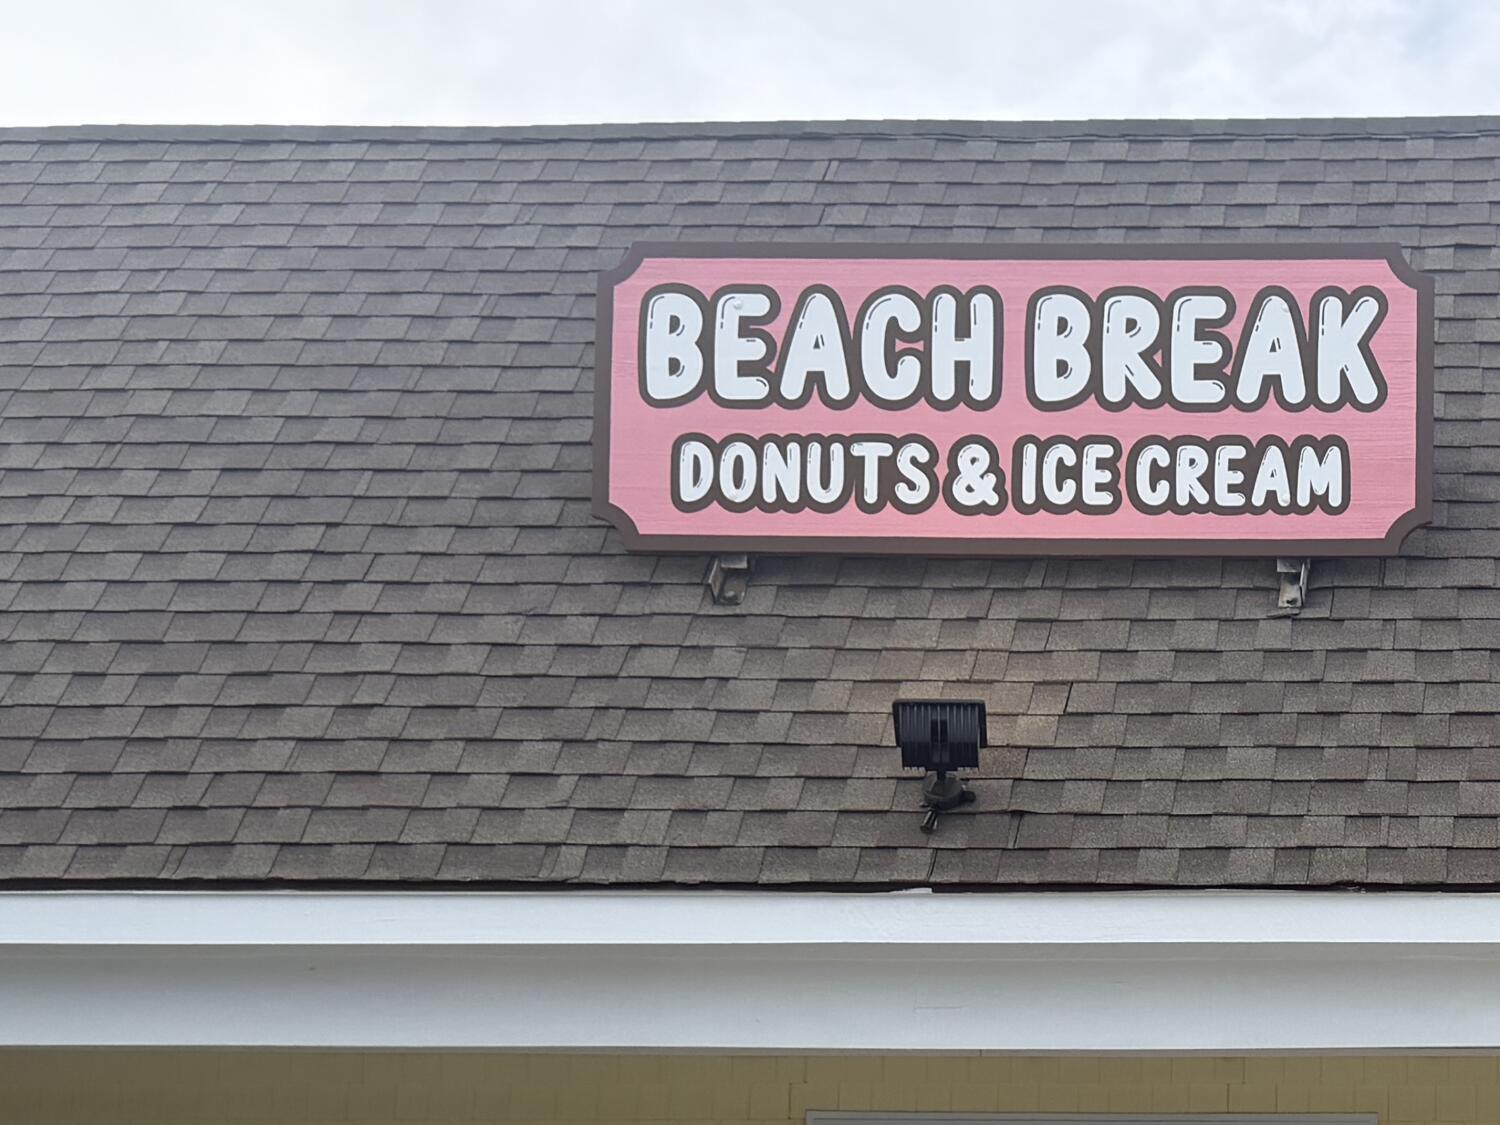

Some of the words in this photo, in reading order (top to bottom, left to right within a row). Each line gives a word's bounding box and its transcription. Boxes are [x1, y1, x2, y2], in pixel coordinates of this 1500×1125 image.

[644, 289, 999, 403] BEACH
[1033, 290, 1388, 406] BREAK
[678, 439, 934, 507] DONUTS
[953, 442, 1001, 507] &
[1020, 441, 1114, 507] ICE
[1135, 441, 1344, 509] CREAM
